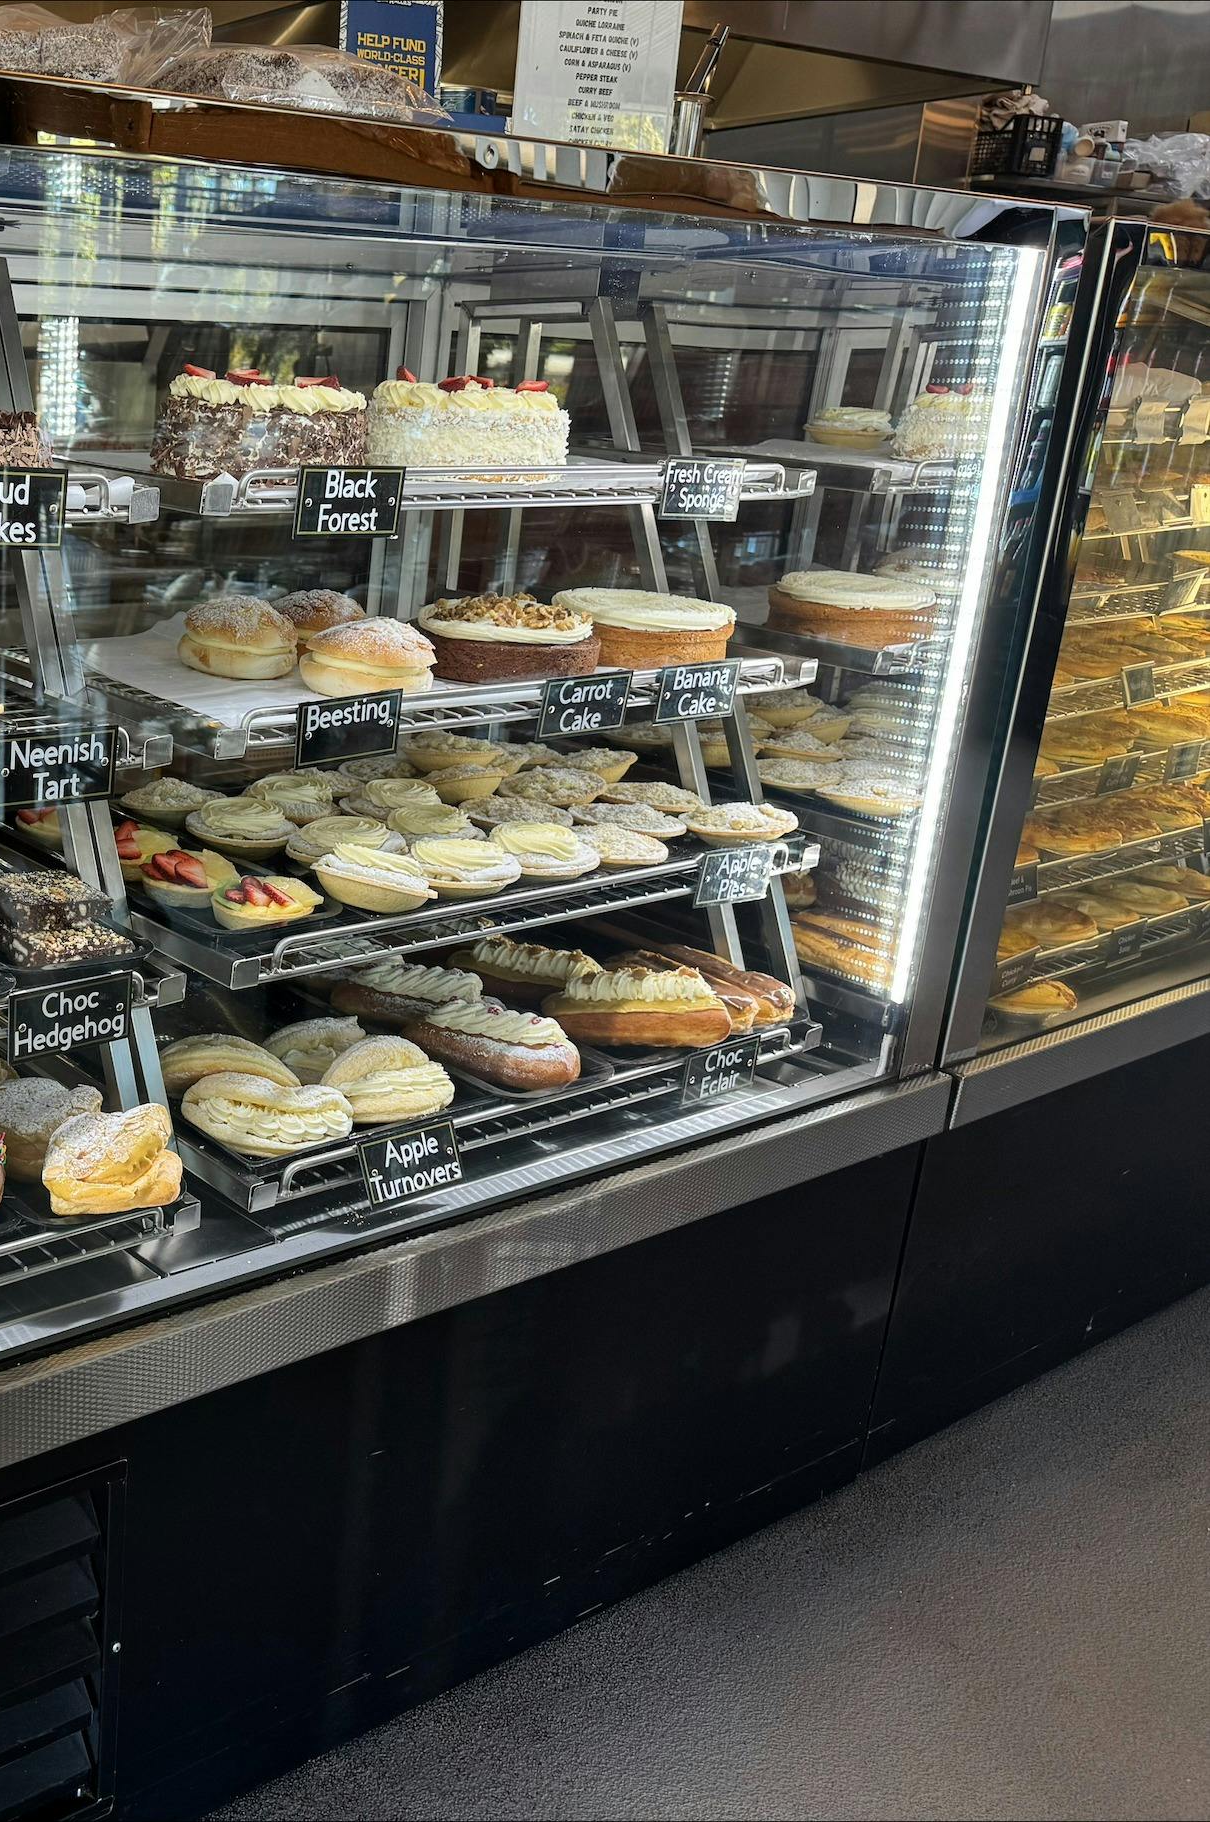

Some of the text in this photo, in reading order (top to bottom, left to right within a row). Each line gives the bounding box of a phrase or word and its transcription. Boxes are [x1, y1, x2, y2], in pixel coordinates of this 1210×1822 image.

[587, 6, 619, 17] PARTY PIE
[575, 19, 625, 31] QUICHE LORRAINE
[357, 32, 426, 53] HELP FUND
[558, 31, 639, 47] SPINACH & FETA QUICHE (V)
[357, 48, 426, 66] WORLD-CLASS
[559, 44, 598, 55] CAULIFLOWER
[605, 49, 628, 58] CHEESE
[629, 50, 638, 60] (V)
[564, 59, 580, 67] CORN
[587, 61, 621, 71] ASPARAGUS
[622, 62, 632, 73] (V)
[575, 73, 618, 83] PEPPER STEAK
[567, 98, 583, 107] BEEF
[578, 86, 613, 96] CURRY BEEF
[325, 469, 378, 499] Black
[666, 462, 744, 485] Fresh Cream
[678, 486, 726, 513] Sponge
[317, 503, 378, 532] Forest
[672, 667, 731, 691] Banana
[559, 679, 614, 705] Carrot
[306, 697, 391, 732] Beesting
[677, 693, 717, 716] Cake
[558, 706, 602, 732] Cake
[9, 733, 105, 770] Neenish
[33, 772, 80, 801] Tart
[716, 850, 762, 879] Apple
[717, 879, 747, 900] Pies
[41, 991, 100, 1018] Choc
[14, 1013, 125, 1057] Hedgehog
[705, 1049, 744, 1072] Choc
[699, 1069, 740, 1099] Eclair
[385, 1131, 439, 1168] Apple
[369, 1161, 463, 1203] Turnovers
